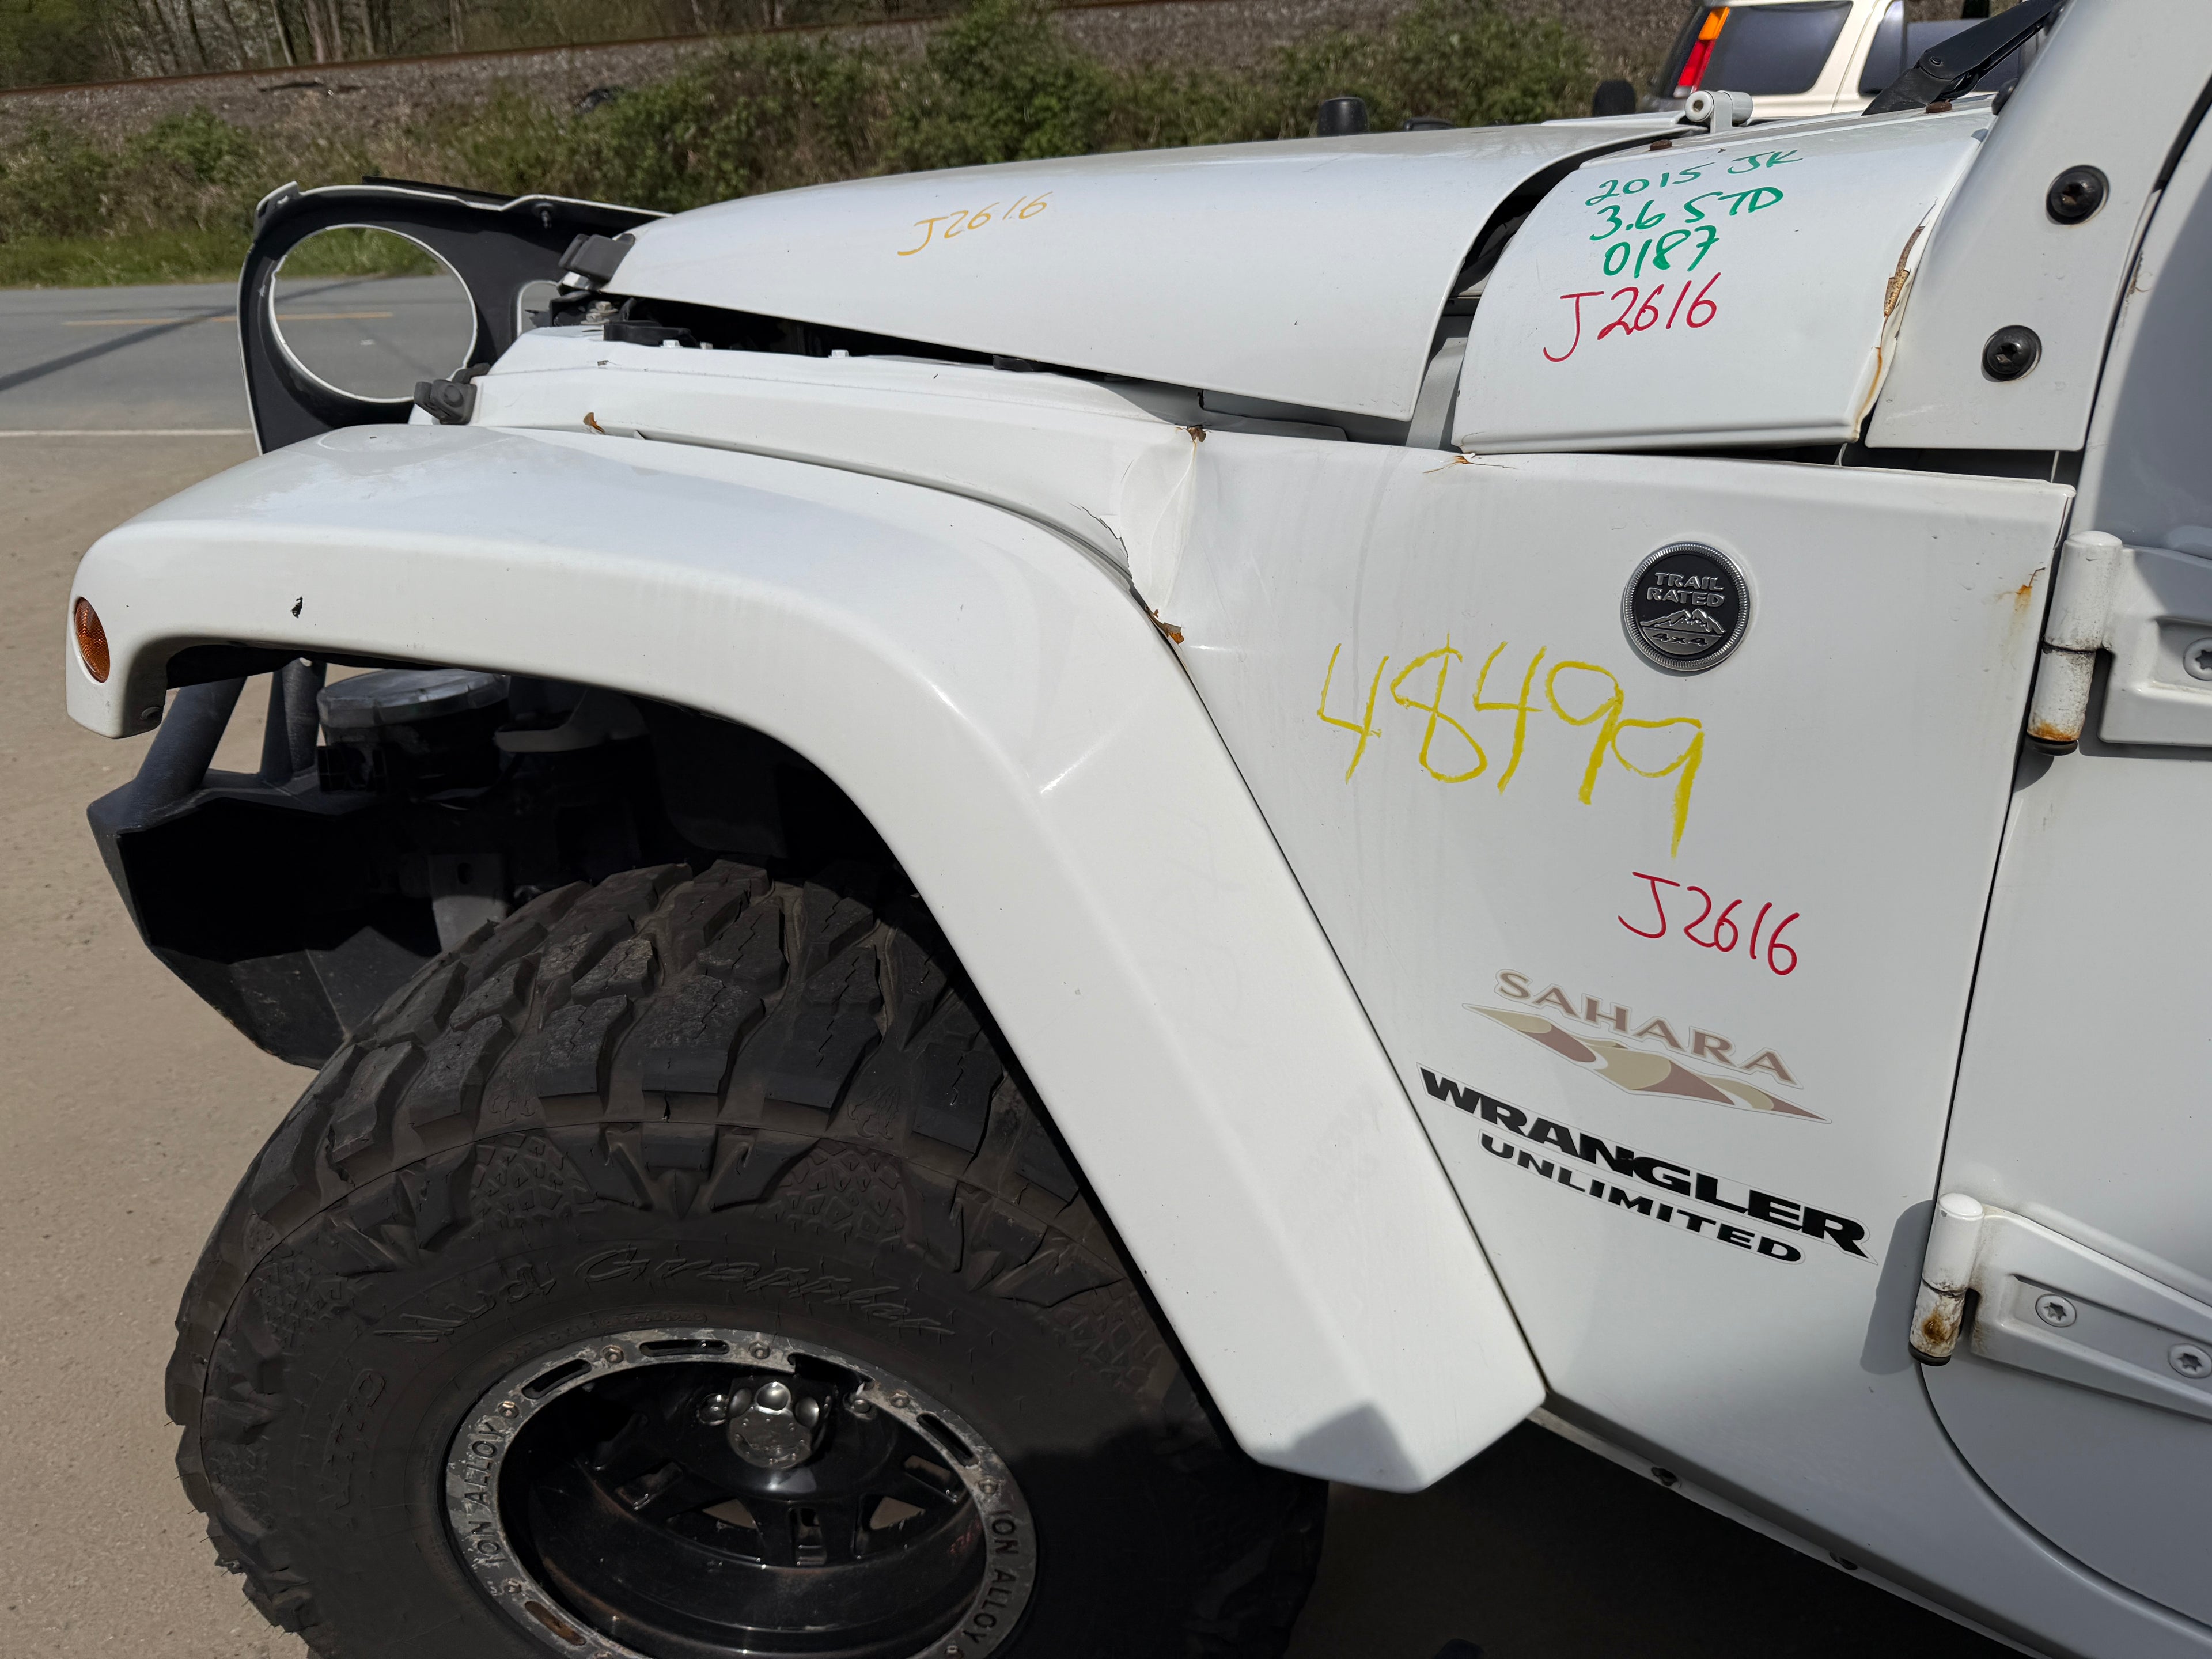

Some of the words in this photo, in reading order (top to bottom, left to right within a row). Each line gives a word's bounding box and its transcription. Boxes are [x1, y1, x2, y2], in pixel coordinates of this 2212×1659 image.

[1585, 162, 1715, 207] 2015
[1728, 150, 1803, 175] JK
[897, 191, 1053, 256] J2616
[1589, 200, 1666, 241] 3.6
[1683, 186, 1784, 224] STD
[1603, 225, 1719, 279] 0187
[1543, 272, 1721, 363] J2616
[1646, 586, 1725, 607] RATED
[1654, 572, 1724, 592] TRAIL
[1651, 633, 1709, 647] 4x4
[1316, 632, 1705, 860] 48499
[1618, 871, 1801, 976] J2616
[1497, 969, 1801, 1085] SAHARA
[1419, 1067, 1870, 1259] WRANGLER
[1480, 1131, 1802, 1263] UNLIMITED
[464, 1421, 507, 1509] ALLOY
[468, 1521, 509, 1565] ION
[987, 1509, 1020, 1555] ION
[961, 1568, 1017, 1645] ALLOY
